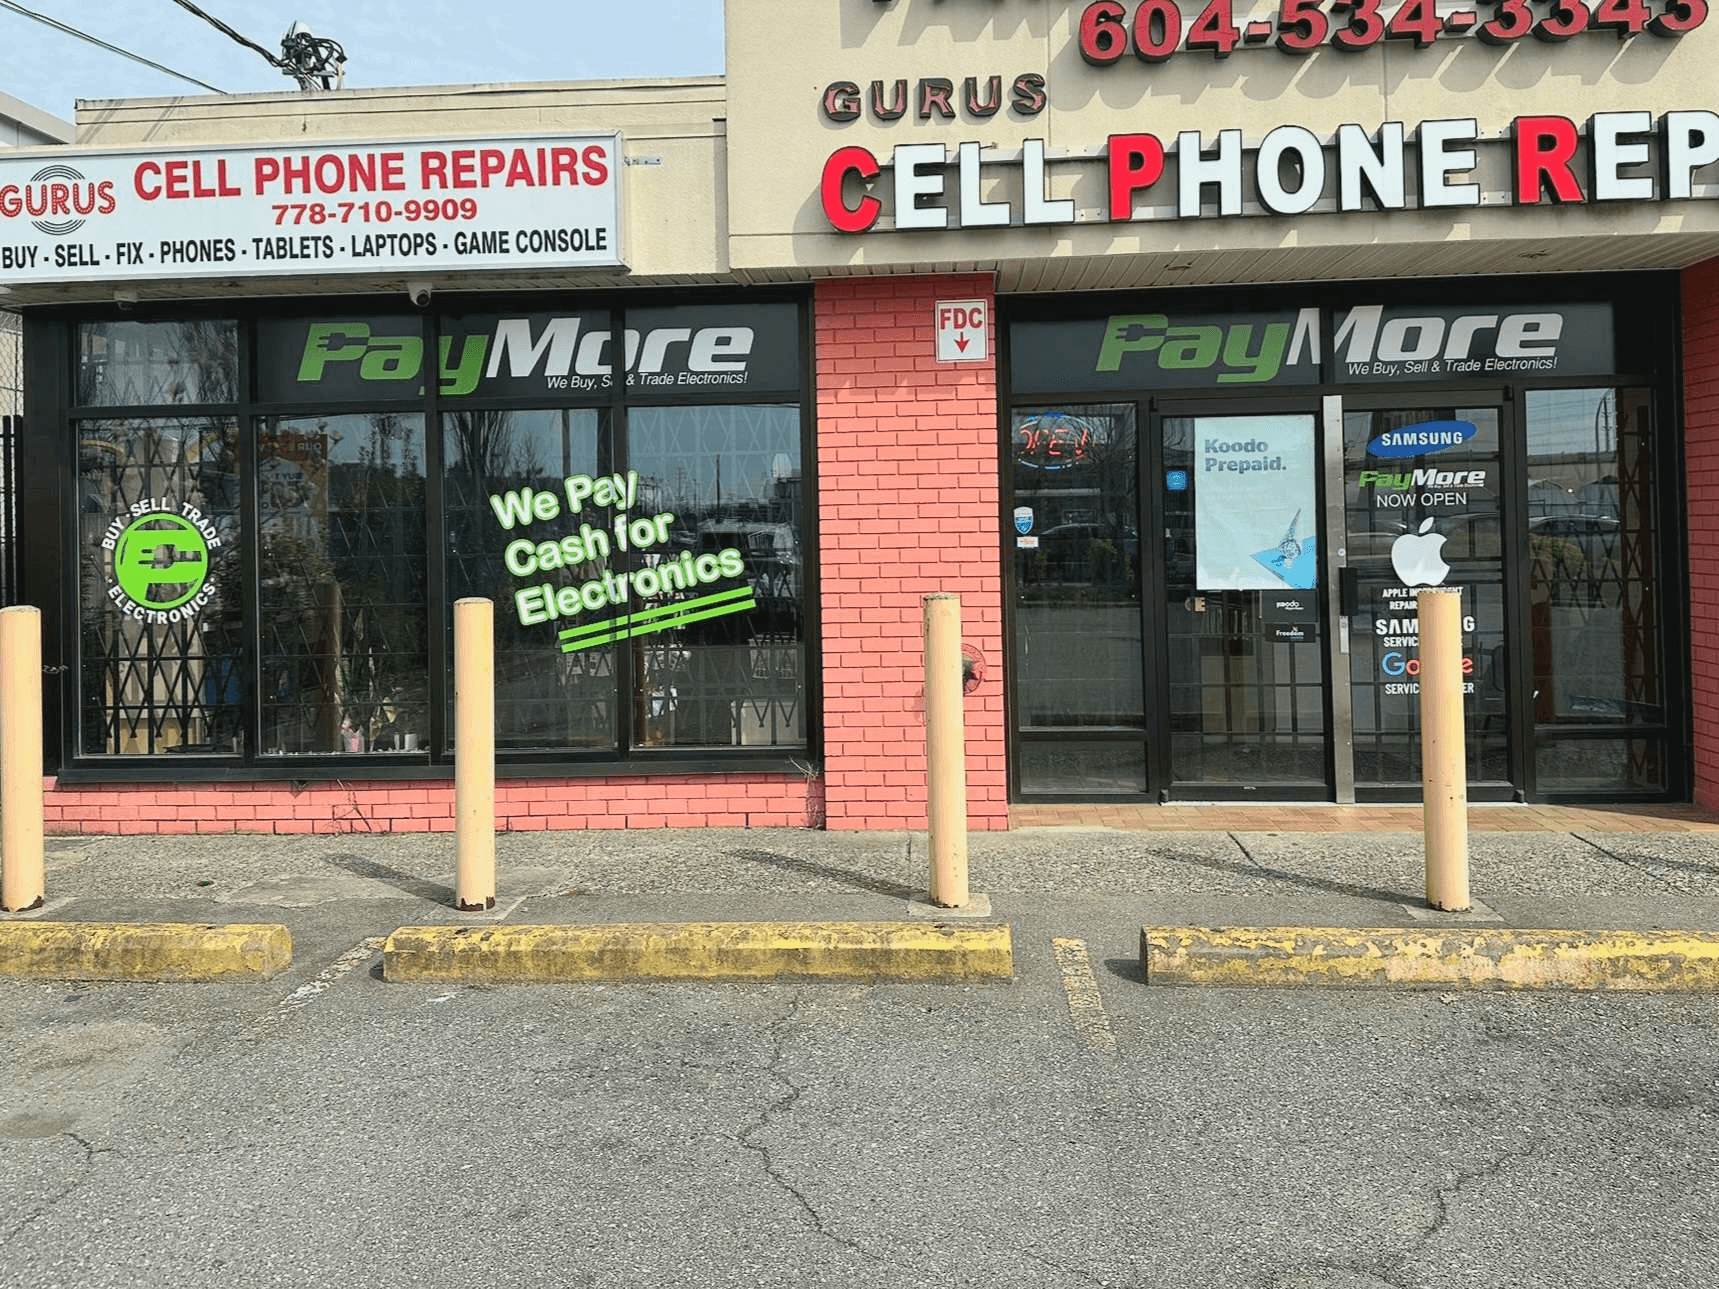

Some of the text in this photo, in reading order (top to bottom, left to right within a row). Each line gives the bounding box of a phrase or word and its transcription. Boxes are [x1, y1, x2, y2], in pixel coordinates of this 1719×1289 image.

[823, 73, 1047, 122] GURUS
[134, 145, 609, 201] CELL PHONE REPAIRS
[821, 138, 1075, 233] CELL
[1108, 118, 1480, 222] PHONE
[0, 181, 116, 217] GURUS
[272, 198, 478, 225] 778-710-9909
[2, 228, 607, 269] BUY SELL FIX PHONES TABLETS LAPTOPS GAME CONSOLE
[940, 307, 983, 330] FDC
[297, 317, 754, 395] PayMore
[1095, 305, 1564, 383] PayMore
[1349, 357, 1558, 376] We Buy, Sell & Trade Electronics!
[547, 376, 568, 389] We
[571, 375, 597, 391] Buy,
[640, 372, 674, 385] Trade
[677, 371, 748, 385] Electronics!
[1204, 438, 1269, 453] Koodo
[1381, 431, 1463, 446] SAMSUNG
[1204, 456, 1287, 474] Prepaid.
[1359, 468, 1487, 491] PayMore
[490, 470, 639, 530] We Pay
[1376, 491, 1467, 508] NOW OPEN
[101, 497, 221, 550] BUY SELL TRADE
[505, 512, 674, 576] Cash for
[514, 548, 745, 626] Electronics
[1382, 588, 1408, 598] APPLE
[107, 584, 216, 624] ELECTRONICS
[1375, 616, 1475, 635] SAMG
[1383, 636, 1419, 647] SERVIC
[1382, 651, 1473, 676] Goe
[1385, 683, 1420, 694] SERVIC
